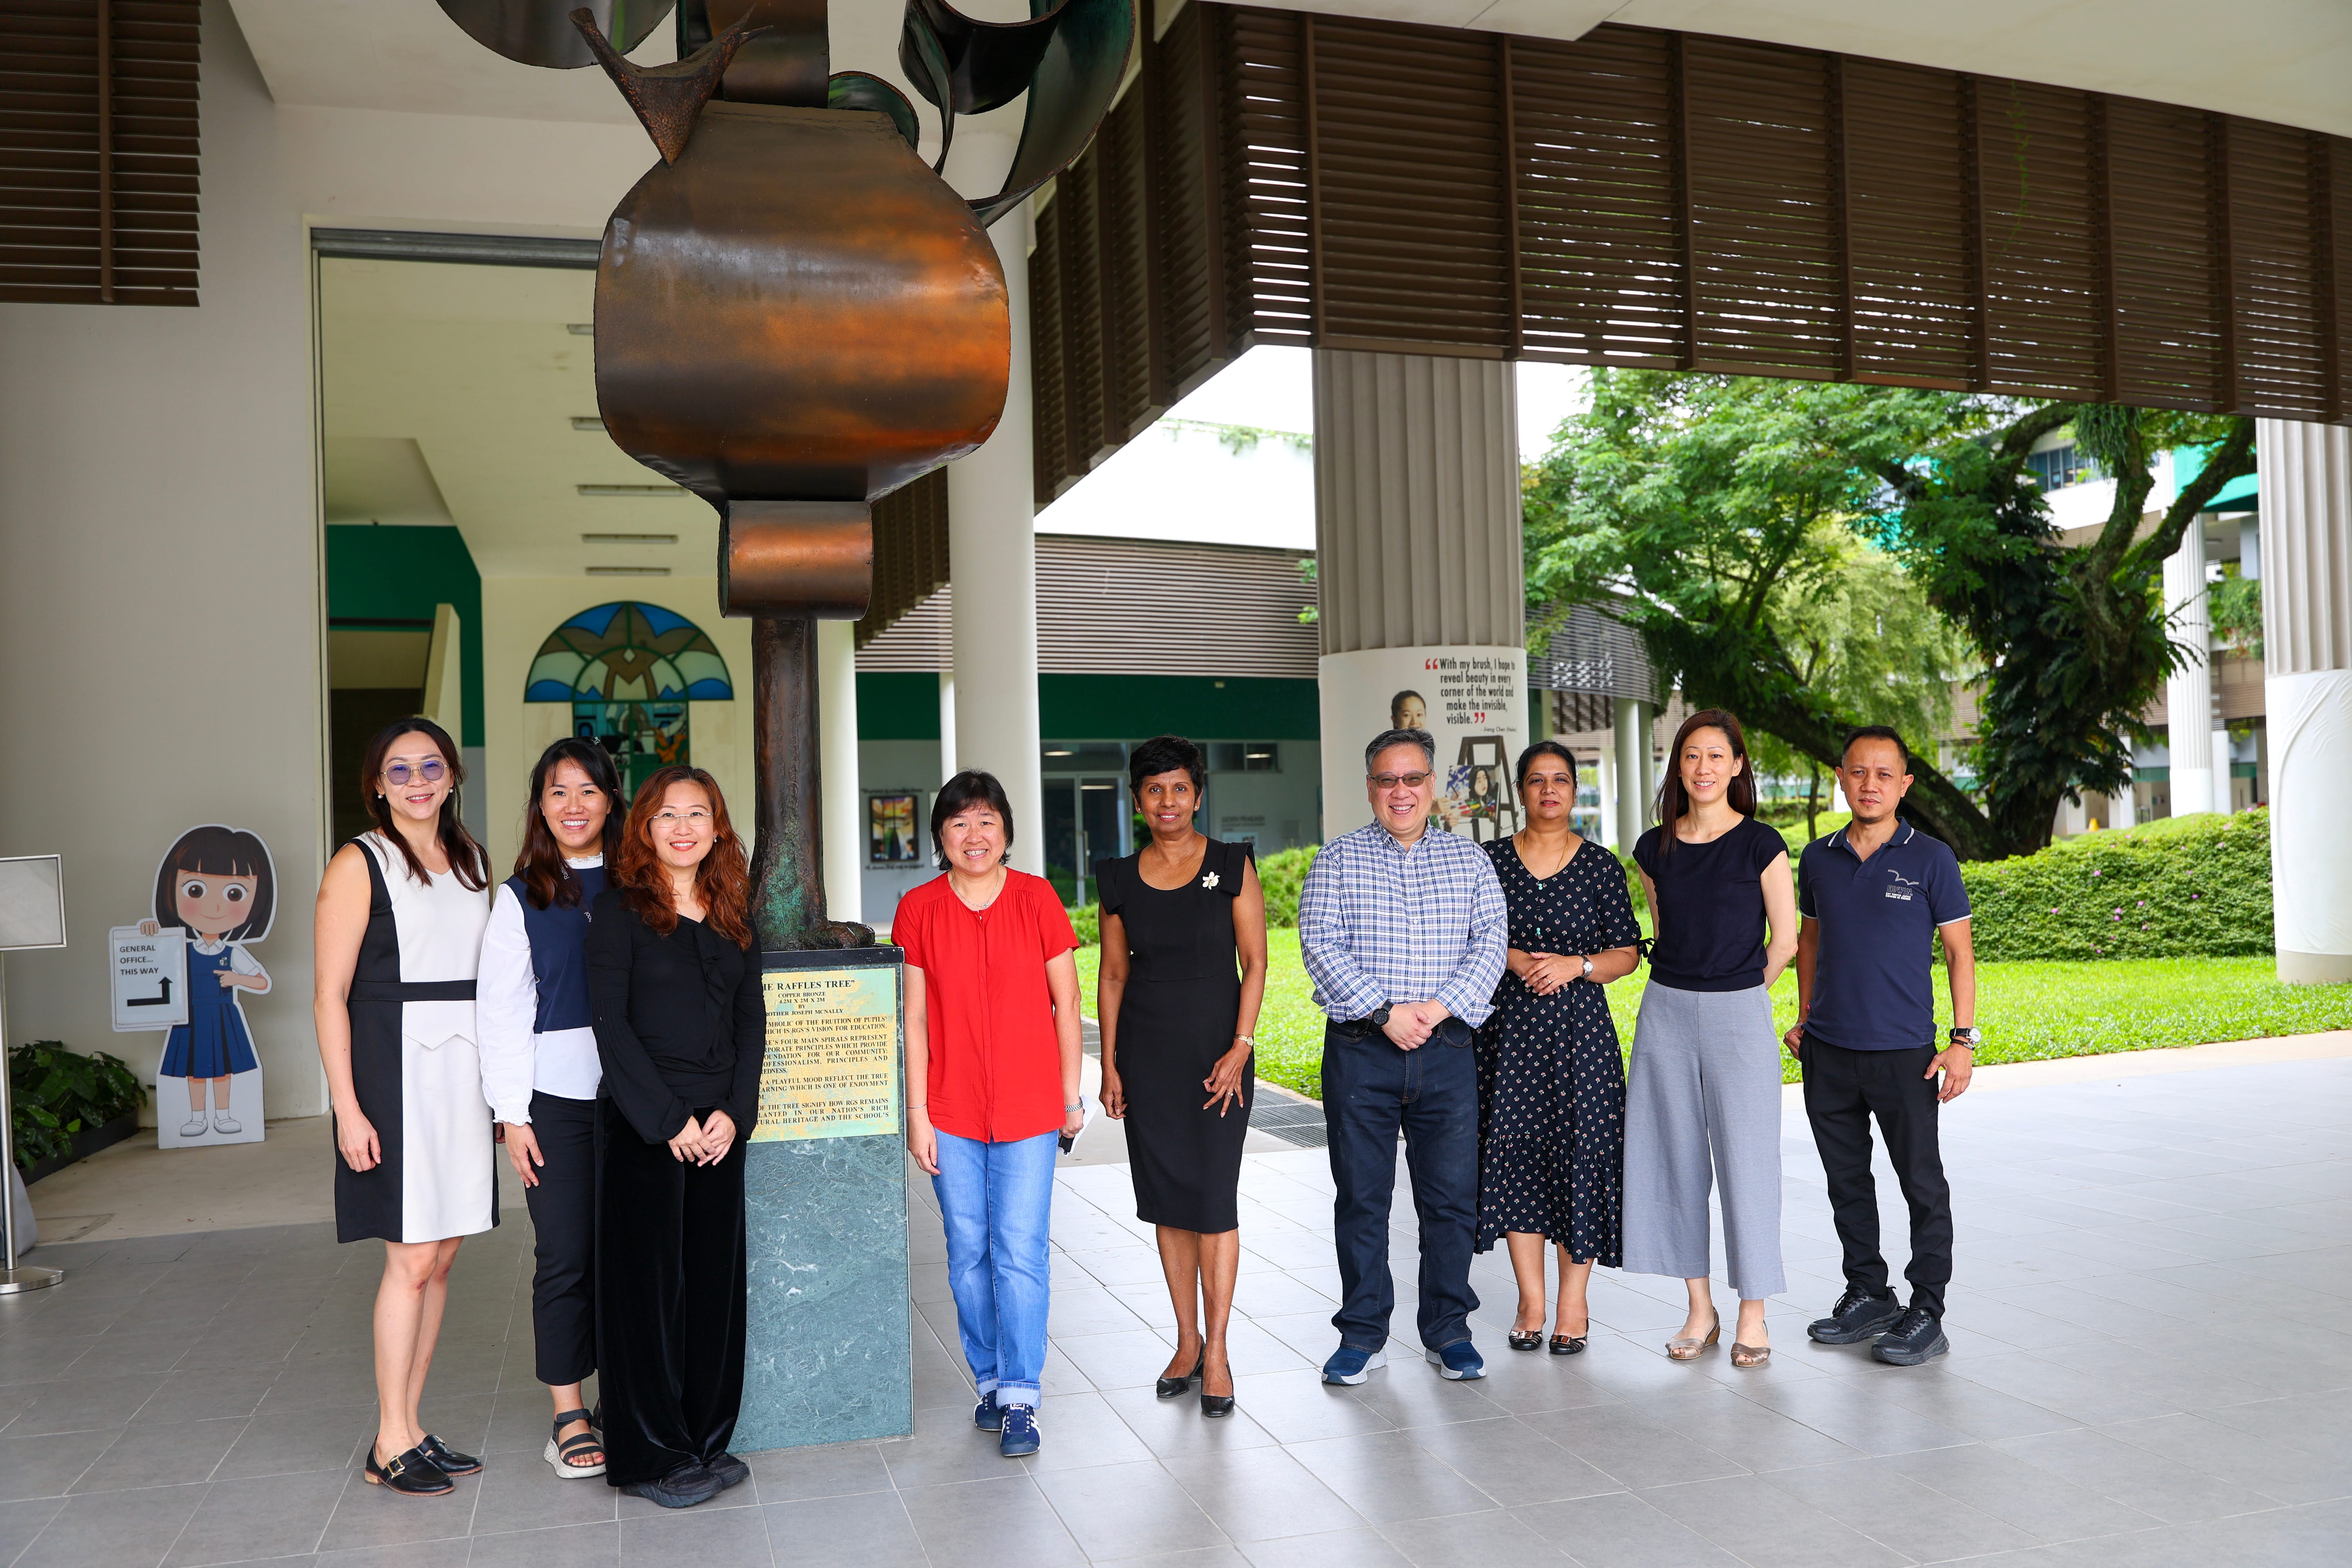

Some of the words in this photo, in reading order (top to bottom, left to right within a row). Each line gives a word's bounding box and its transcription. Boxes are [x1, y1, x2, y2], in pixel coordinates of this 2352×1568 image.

[1459, 661, 1470, 671] my
[1473, 657, 1493, 671] brush,
[1494, 658, 1496, 669] I
[1498, 657, 1510, 672] hope
[1511, 661, 1515, 670] to
[1440, 671, 1463, 683] reveal
[1466, 671, 1488, 685] beauty
[1490, 673, 1495, 683] in
[1498, 675, 1511, 686] every
[1441, 688, 1464, 697] corner
[1466, 684, 1474, 697] of
[1476, 685, 1486, 697] the
[1488, 686, 1504, 697] world
[1506, 686, 1514, 697] and
[1446, 699, 1466, 710] make
[1469, 699, 1480, 710] the
[1482, 699, 1508, 713] invisible,
[1886, 885, 1912, 896] EDWIN
[120, 945, 156, 953] GENERAL
[777, 982, 821, 990] RAFFLES
